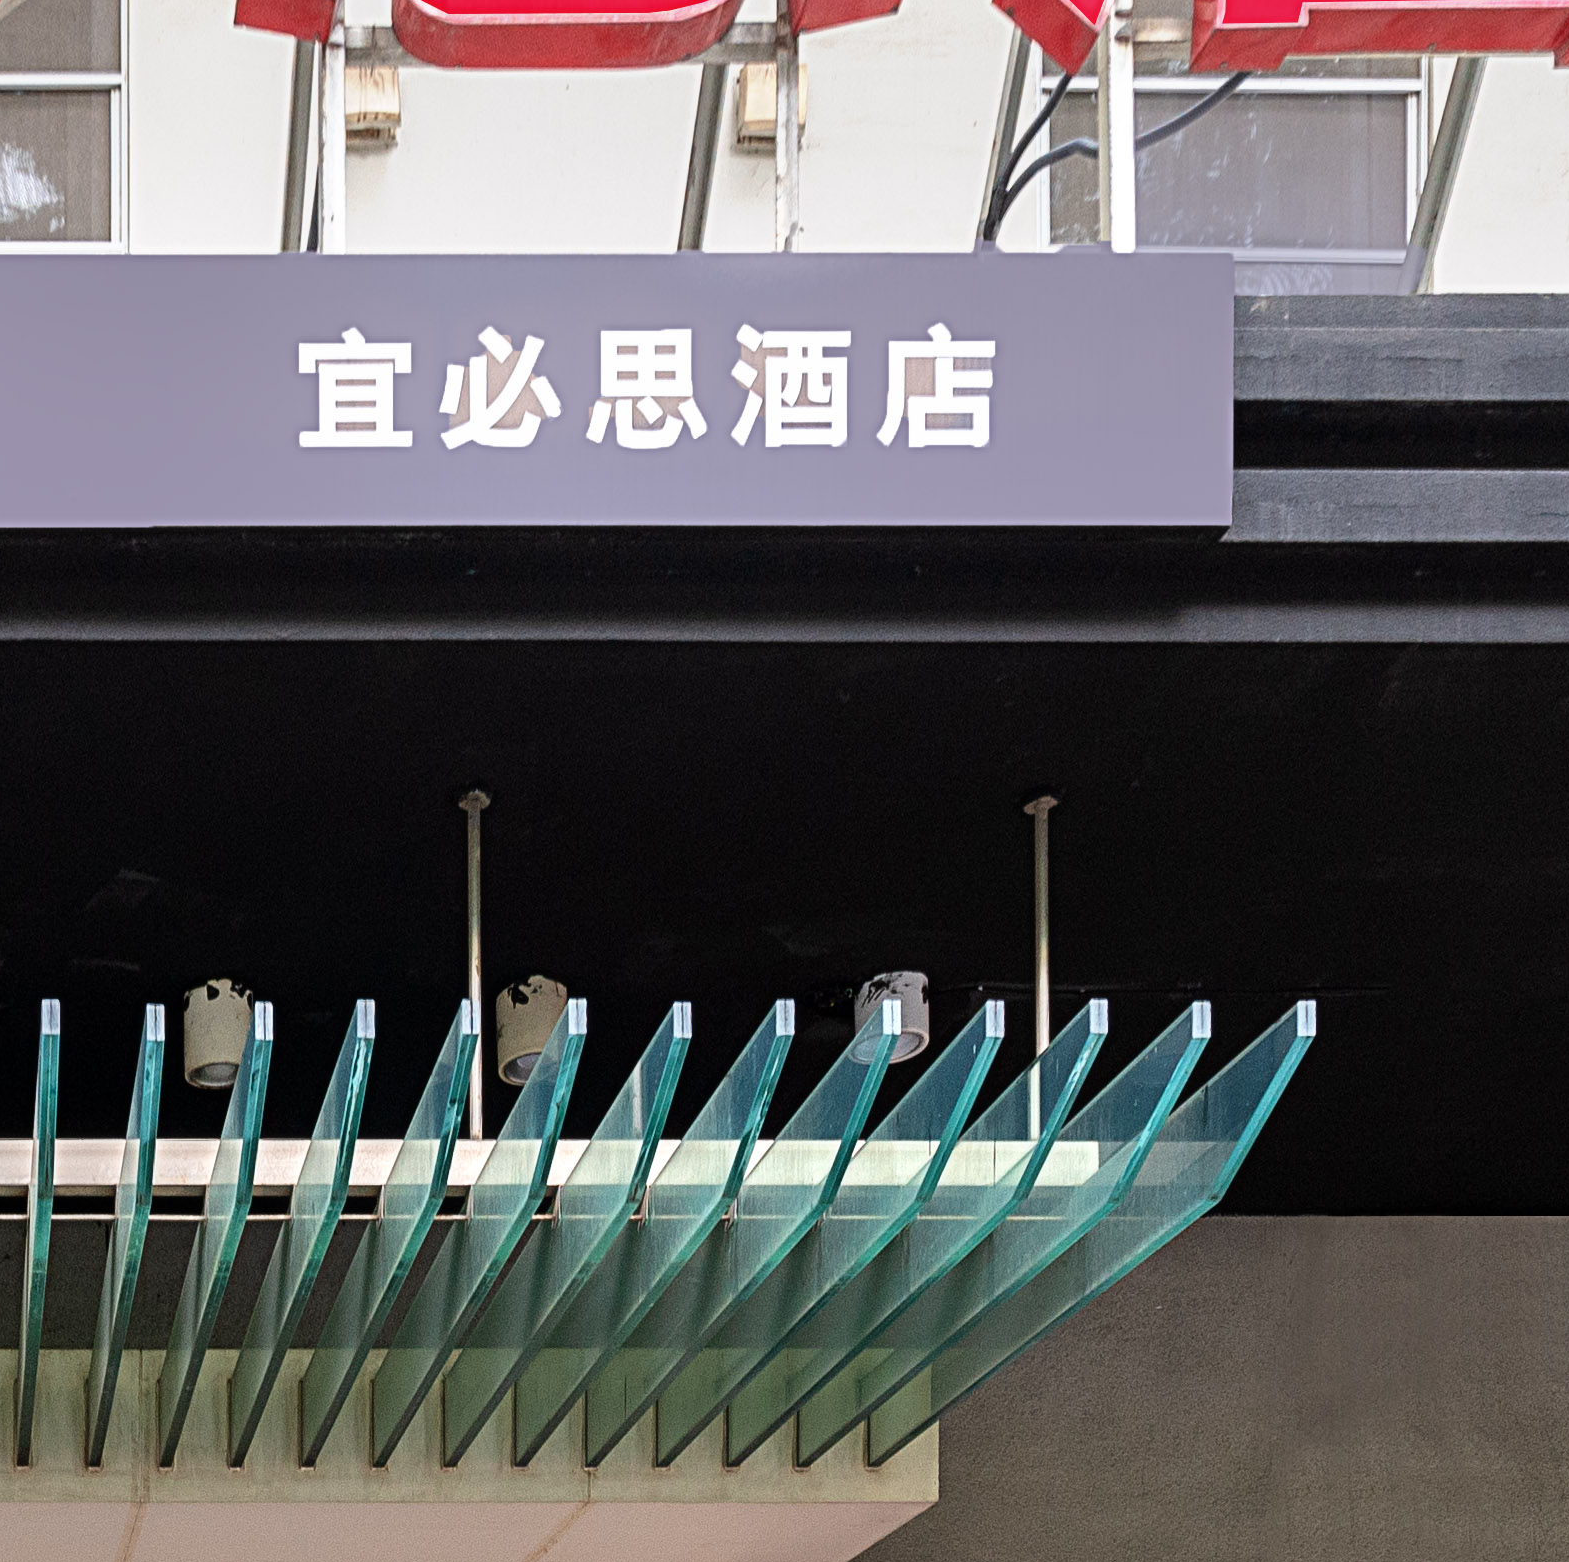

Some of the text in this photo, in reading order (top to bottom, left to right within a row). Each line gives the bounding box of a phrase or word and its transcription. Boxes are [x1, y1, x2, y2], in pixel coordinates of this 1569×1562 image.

[297, 322, 997, 450] 宜必思酒店
